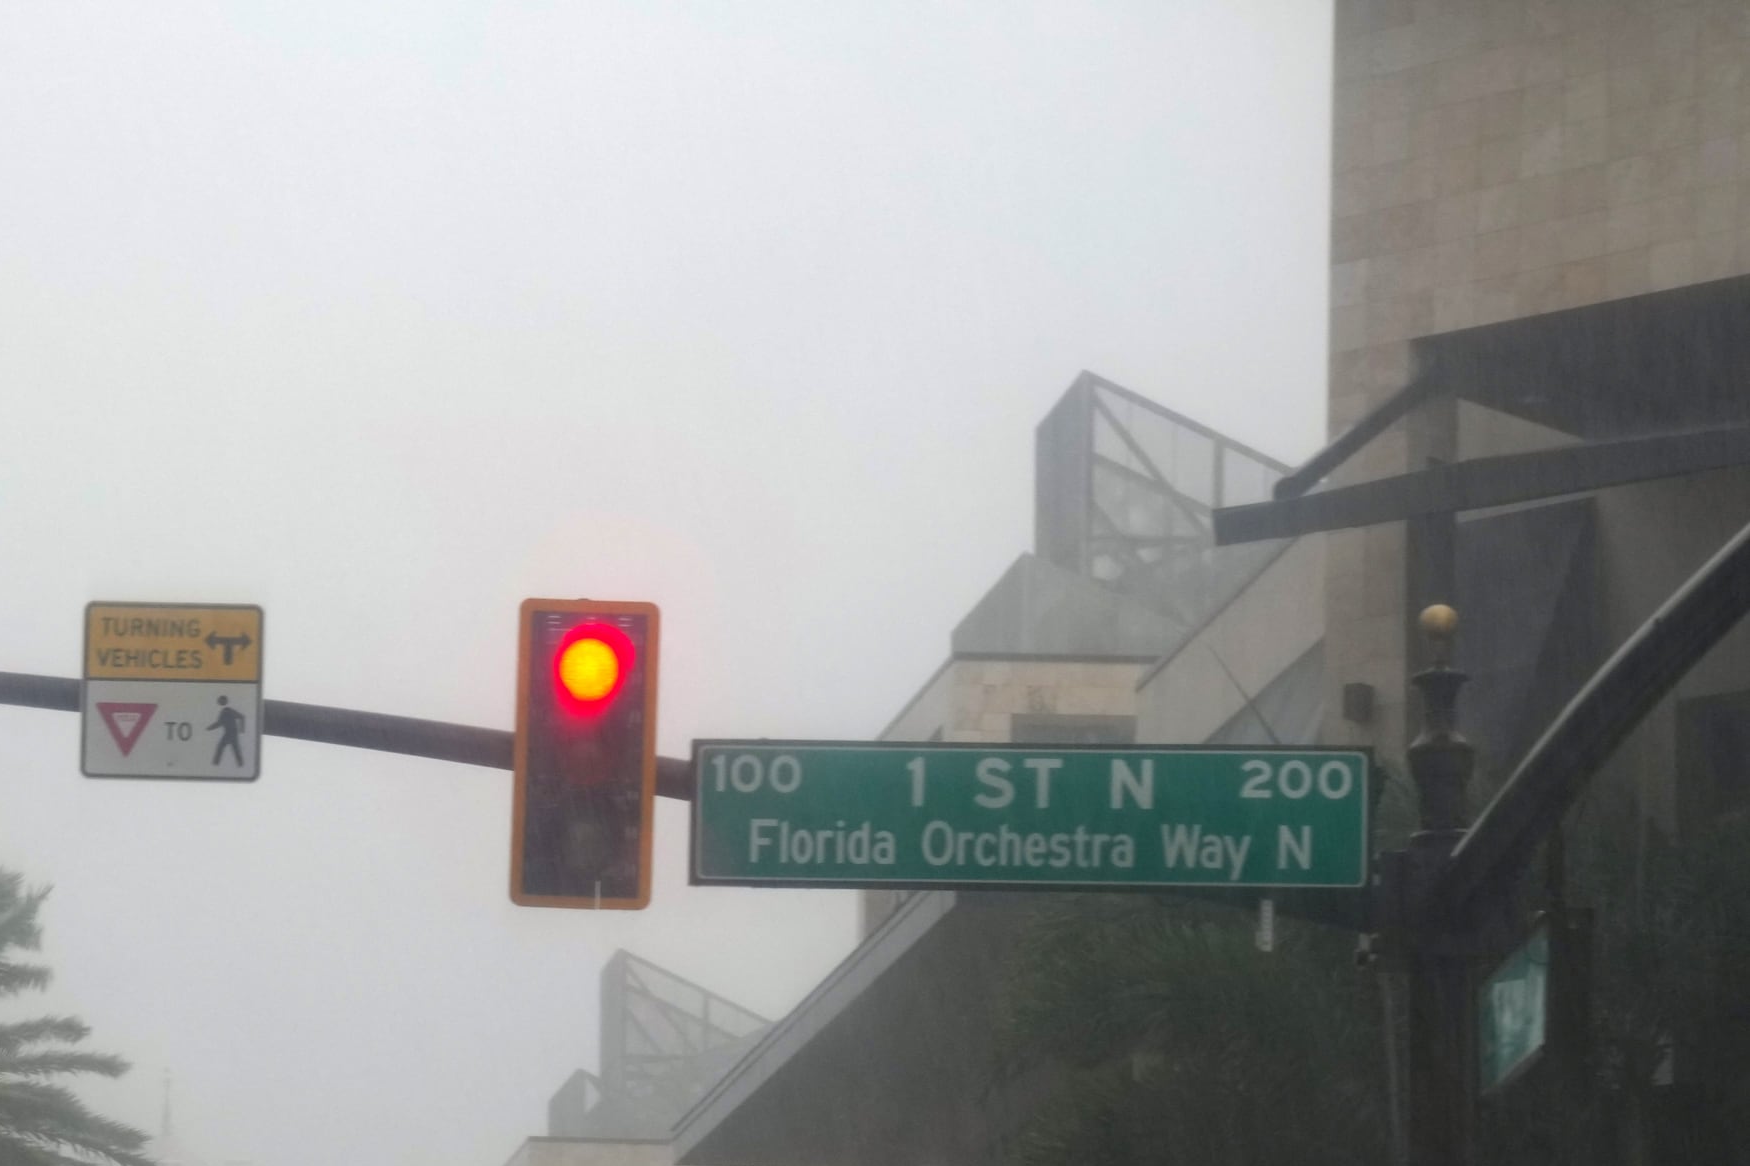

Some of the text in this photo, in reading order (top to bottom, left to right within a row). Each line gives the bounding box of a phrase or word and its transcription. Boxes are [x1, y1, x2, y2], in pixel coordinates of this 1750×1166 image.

[100, 617, 202, 638] TURNING
[97, 649, 203, 669] VEHICLES
[164, 722, 192, 741] TO
[711, 754, 1352, 809] 100 1 ST N 200
[750, 819, 1312, 880] Florida Orchestra Way N
